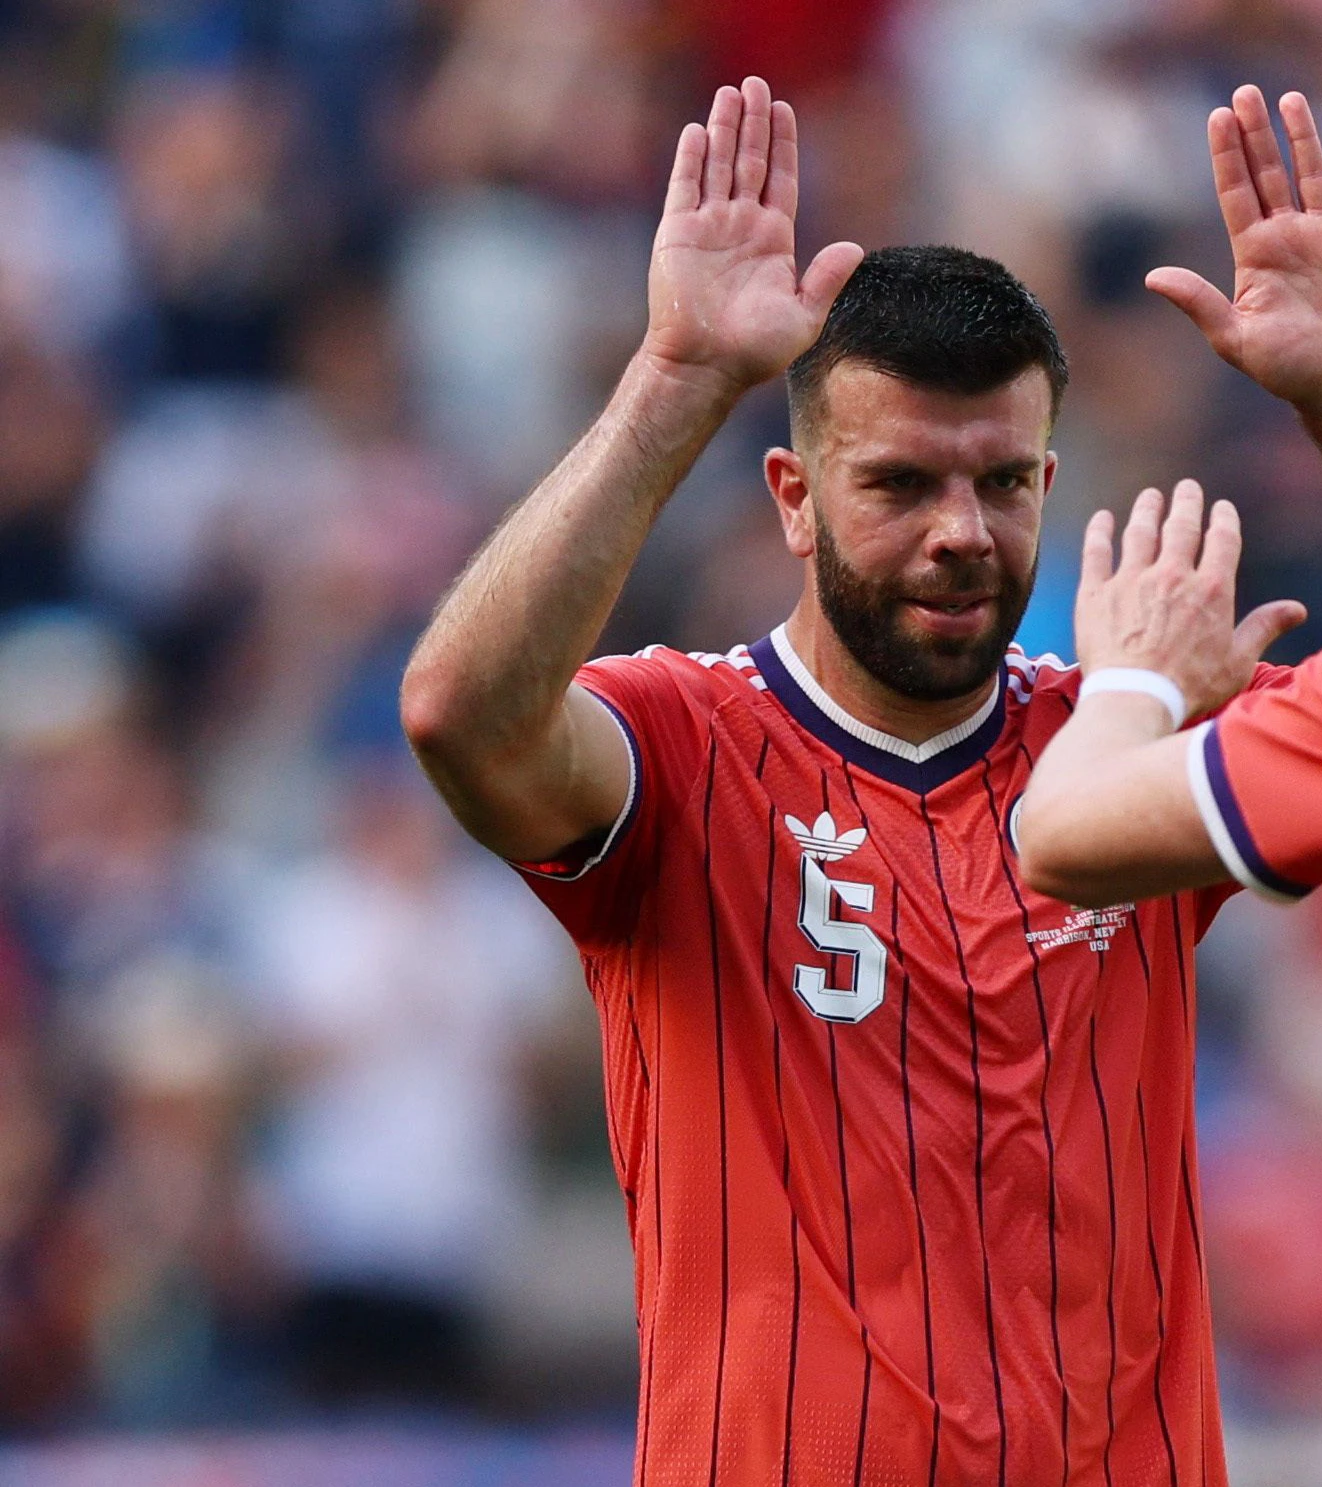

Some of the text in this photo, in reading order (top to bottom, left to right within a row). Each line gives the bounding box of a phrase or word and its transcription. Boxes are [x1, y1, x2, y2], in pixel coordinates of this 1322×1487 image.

[793, 852, 887, 1024] 5
[1025, 929, 1062, 943] SPORTS
[1094, 926, 1116, 938] NEW
[1090, 940, 1110, 952] USA
